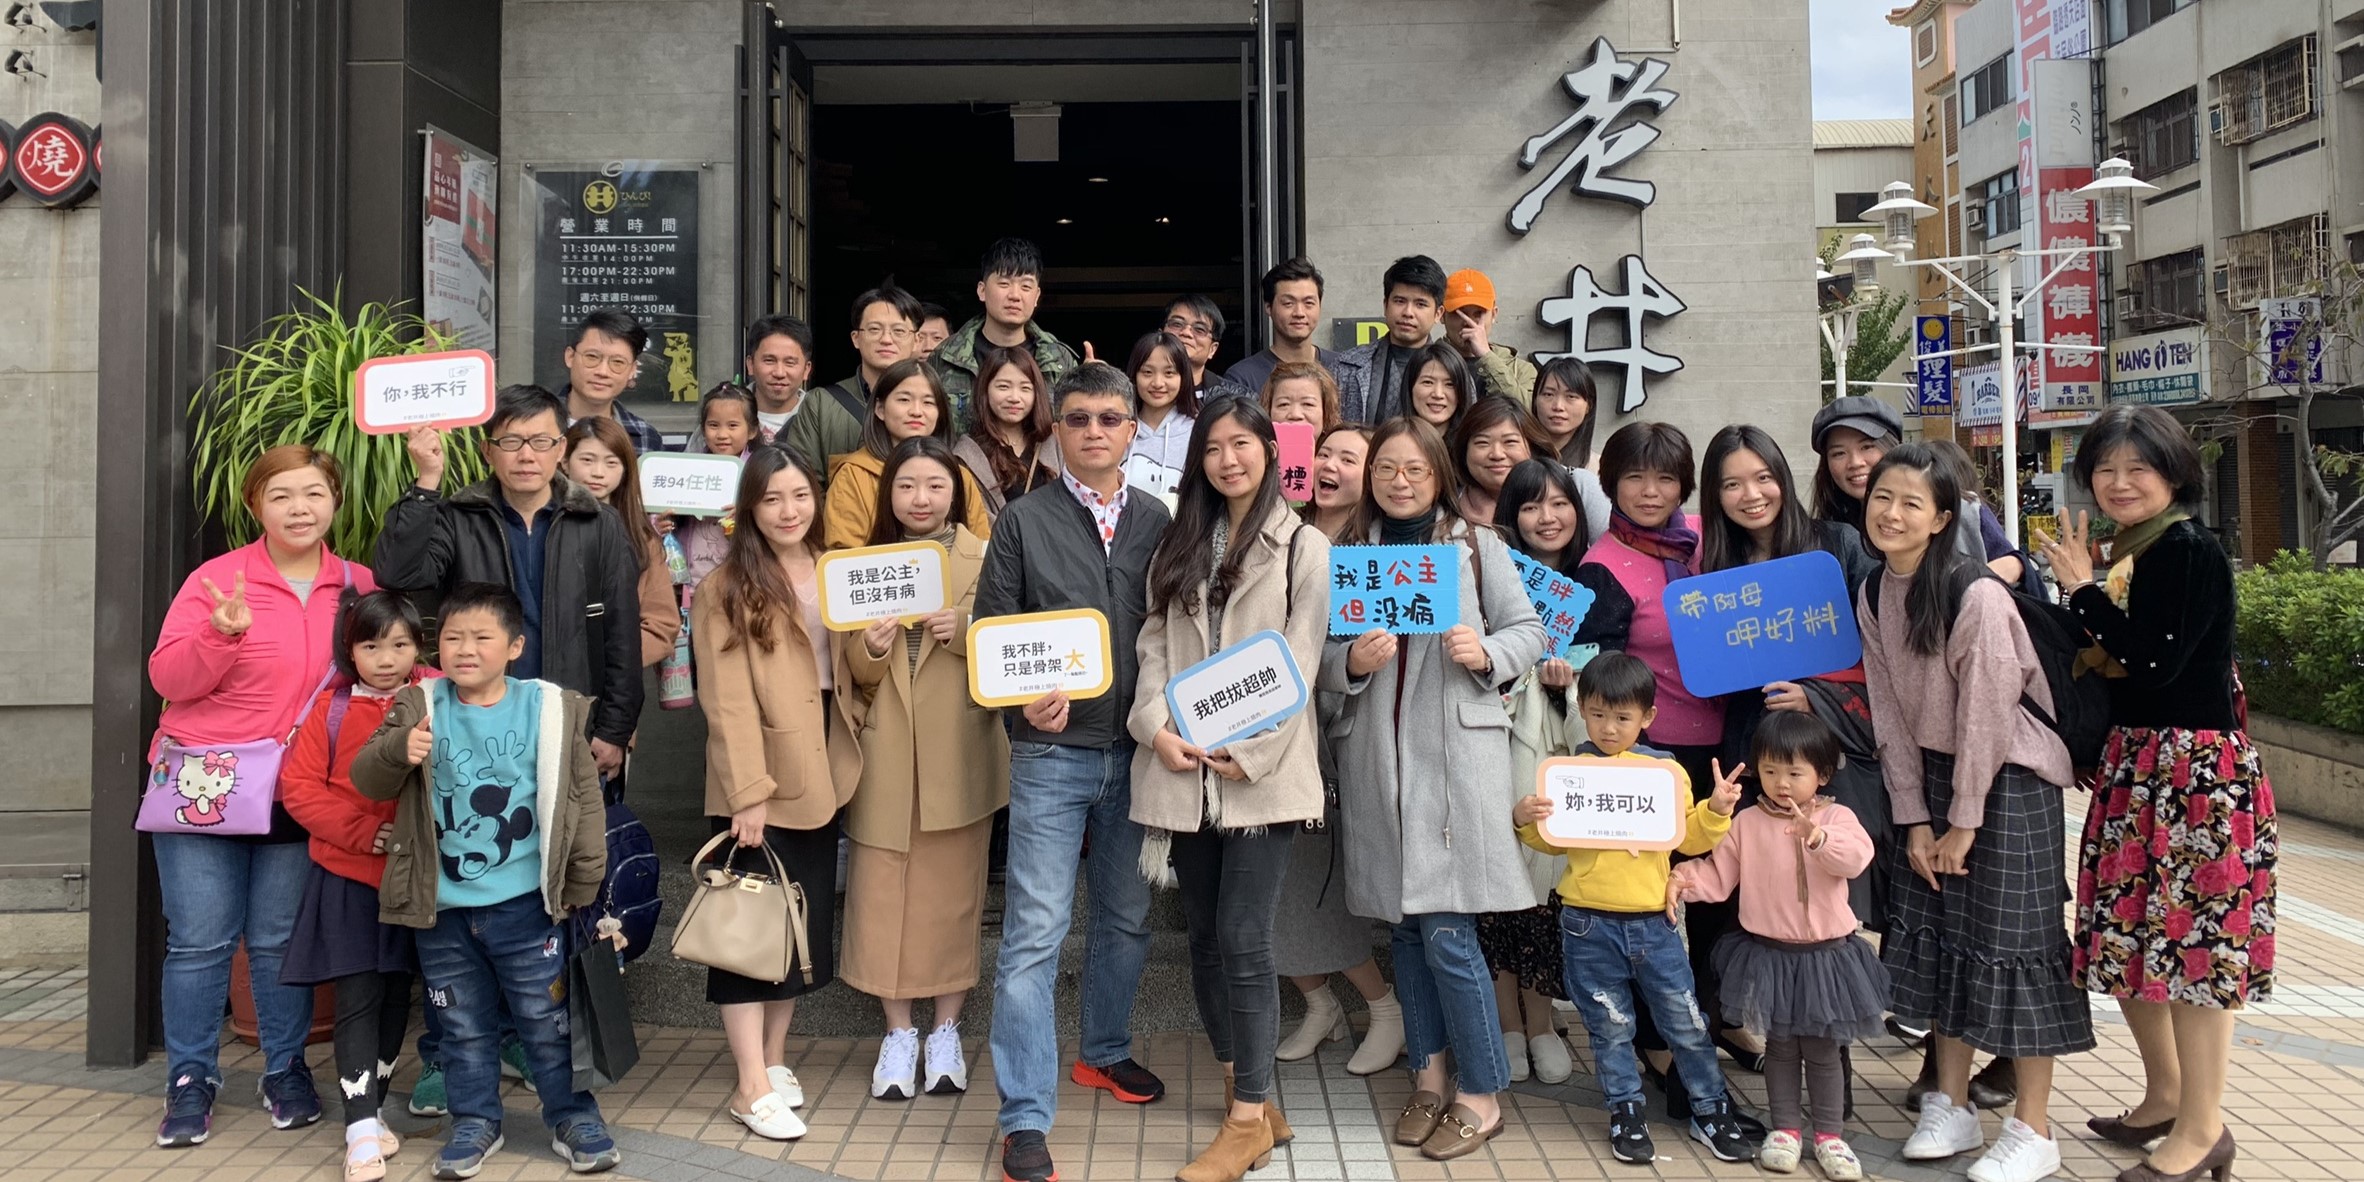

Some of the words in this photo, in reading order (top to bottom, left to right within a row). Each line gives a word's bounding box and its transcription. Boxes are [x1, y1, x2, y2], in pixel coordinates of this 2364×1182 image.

[26, 135, 73, 177] 燒
[560, 218, 677, 233] 營業時間
[562, 244, 675, 253] 11:30AM-15:30PM
[562, 266, 675, 276] 17:00PM-22:30PM
[2116, 347, 2151, 372] HANG
[2169, 341, 2192, 366] TEN
[1922, 358, 1949, 403] 理髮
[2029, 392, 2041, 406] 09
[2057, 396, 2095, 405] 有限公司
[652, 474, 722, 491] 我94任性
[1279, 466, 1307, 491] 標
[1334, 555, 1437, 592] 我是公主
[849, 583, 915, 606] 但沒有病
[1680, 582, 1763, 619] 帶阿母
[1726, 602, 1839, 648] 呷好料
[1193, 666, 1277, 720] 我把拔超帥
